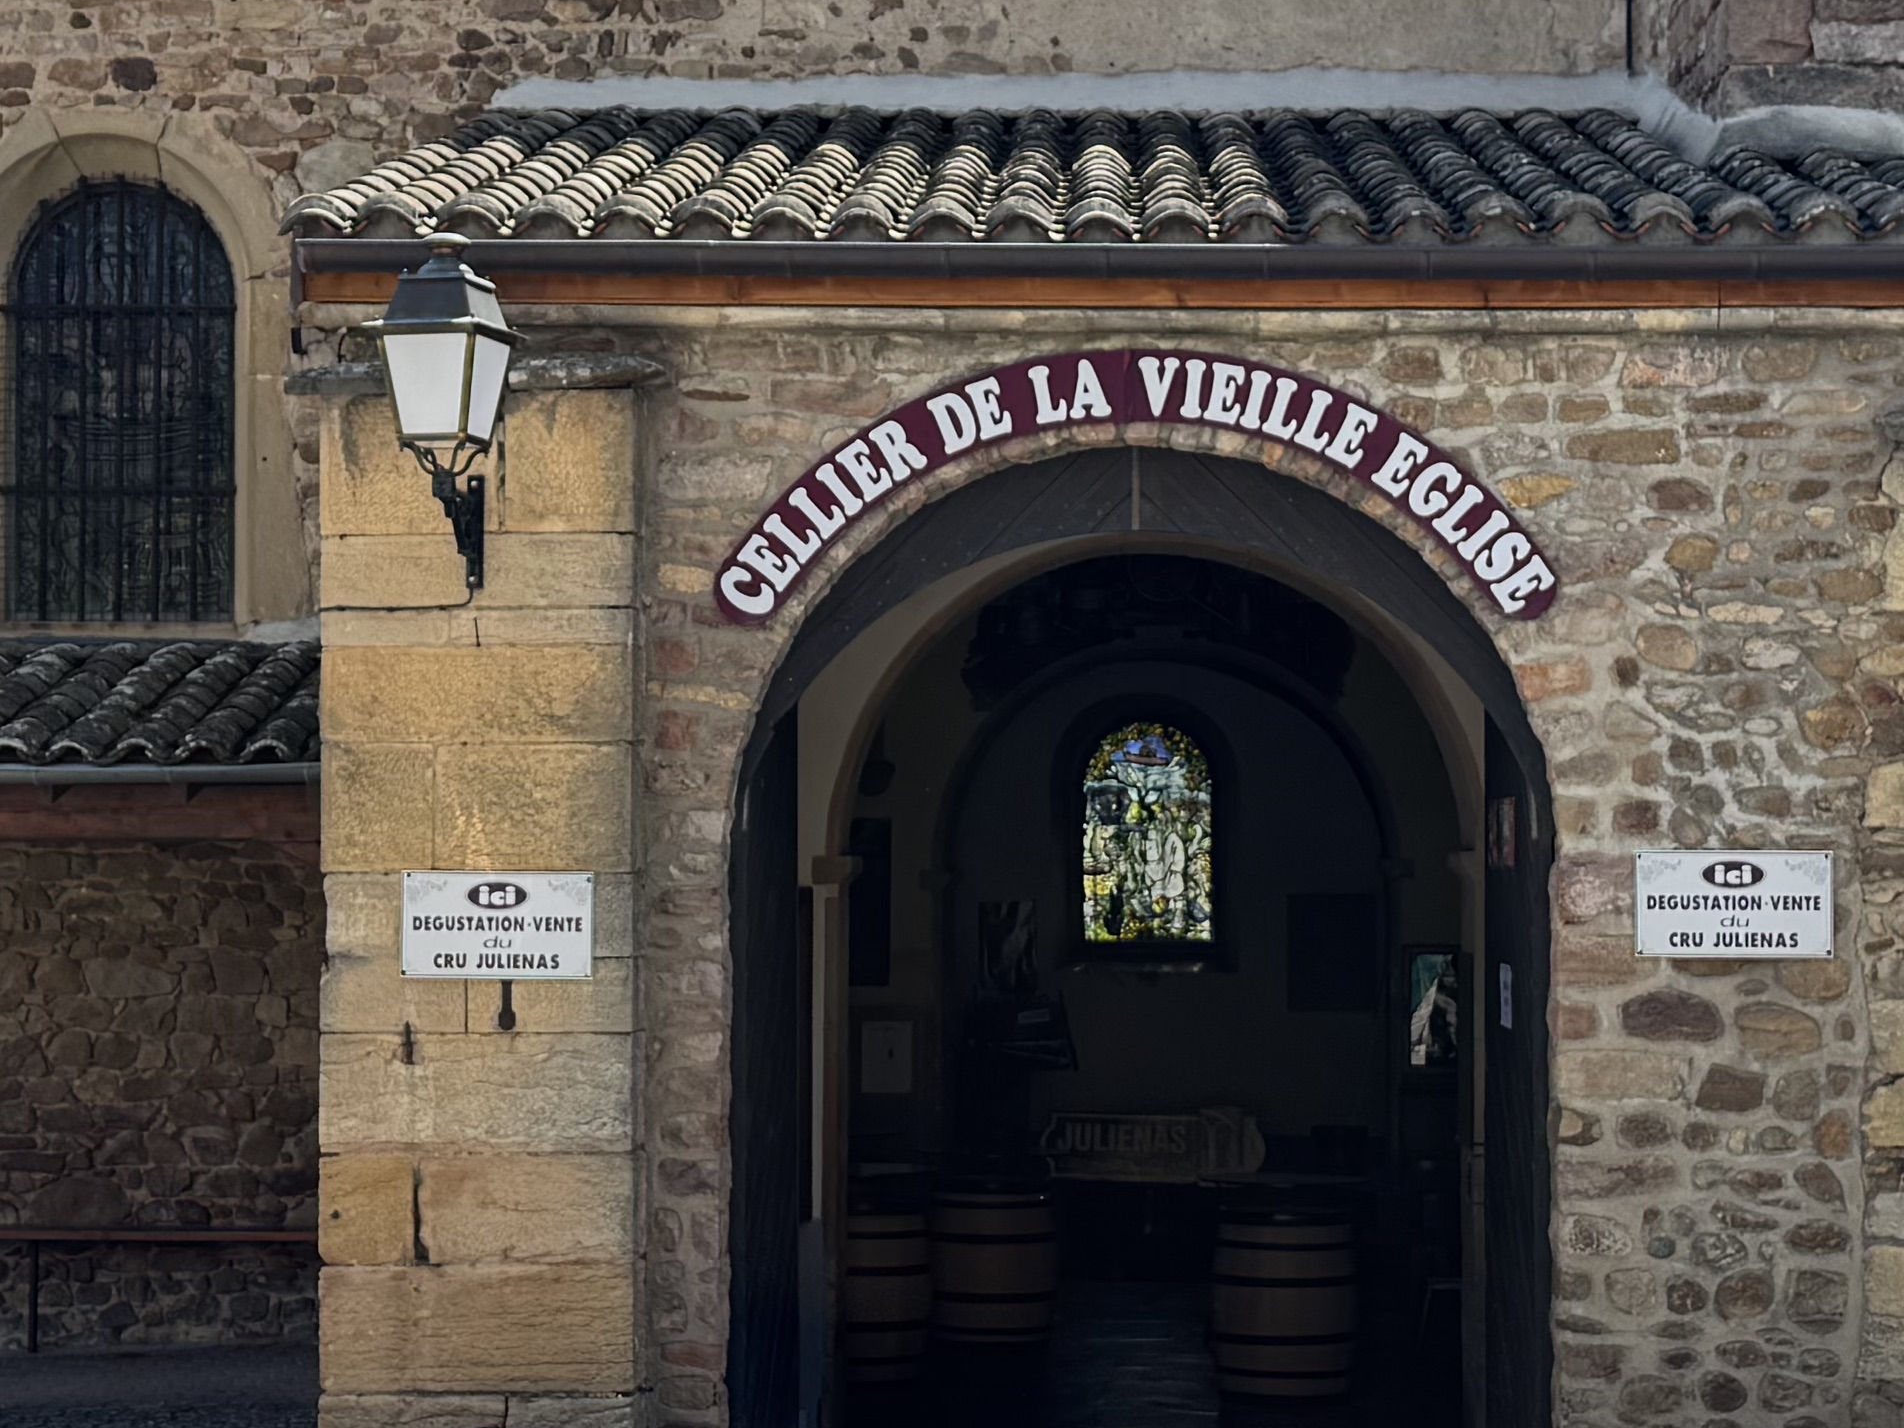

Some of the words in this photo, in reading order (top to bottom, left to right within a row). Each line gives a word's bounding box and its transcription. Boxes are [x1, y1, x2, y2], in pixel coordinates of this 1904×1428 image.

[719, 418, 928, 618] CELLIER
[927, 376, 1012, 454] DE
[1035, 357, 1112, 423] LA
[1138, 354, 1378, 469] VIEILLE
[1369, 436, 1556, 616] EGLISE
[1714, 864, 1753, 885] ici
[478, 885, 517, 906] ici
[1719, 915, 1750, 928] du
[483, 935, 513, 949] du
[1669, 932, 1704, 947] CRU
[1713, 932, 1799, 948] JULIENAS
[433, 953, 468, 969] CRU
[476, 953, 560, 969] JULIENAS
[1057, 1122, 1187, 1154] JULIENAS
